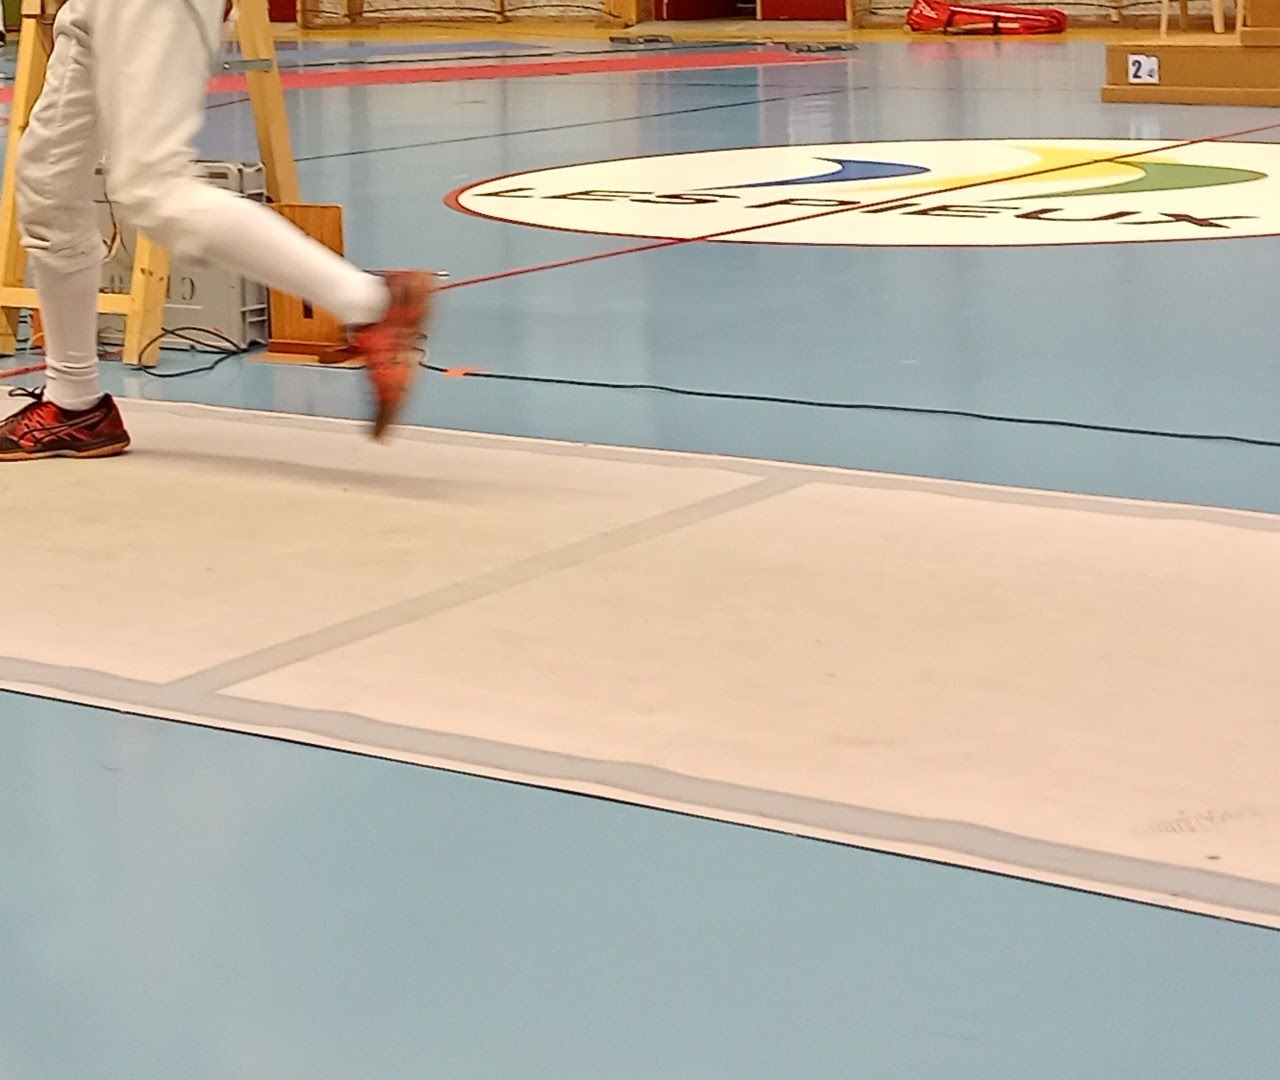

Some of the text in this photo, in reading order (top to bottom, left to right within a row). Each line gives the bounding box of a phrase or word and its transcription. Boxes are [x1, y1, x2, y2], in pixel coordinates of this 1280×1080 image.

[1131, 60, 1142, 79] 2
[471, 187, 1259, 229] LES PIEUX
